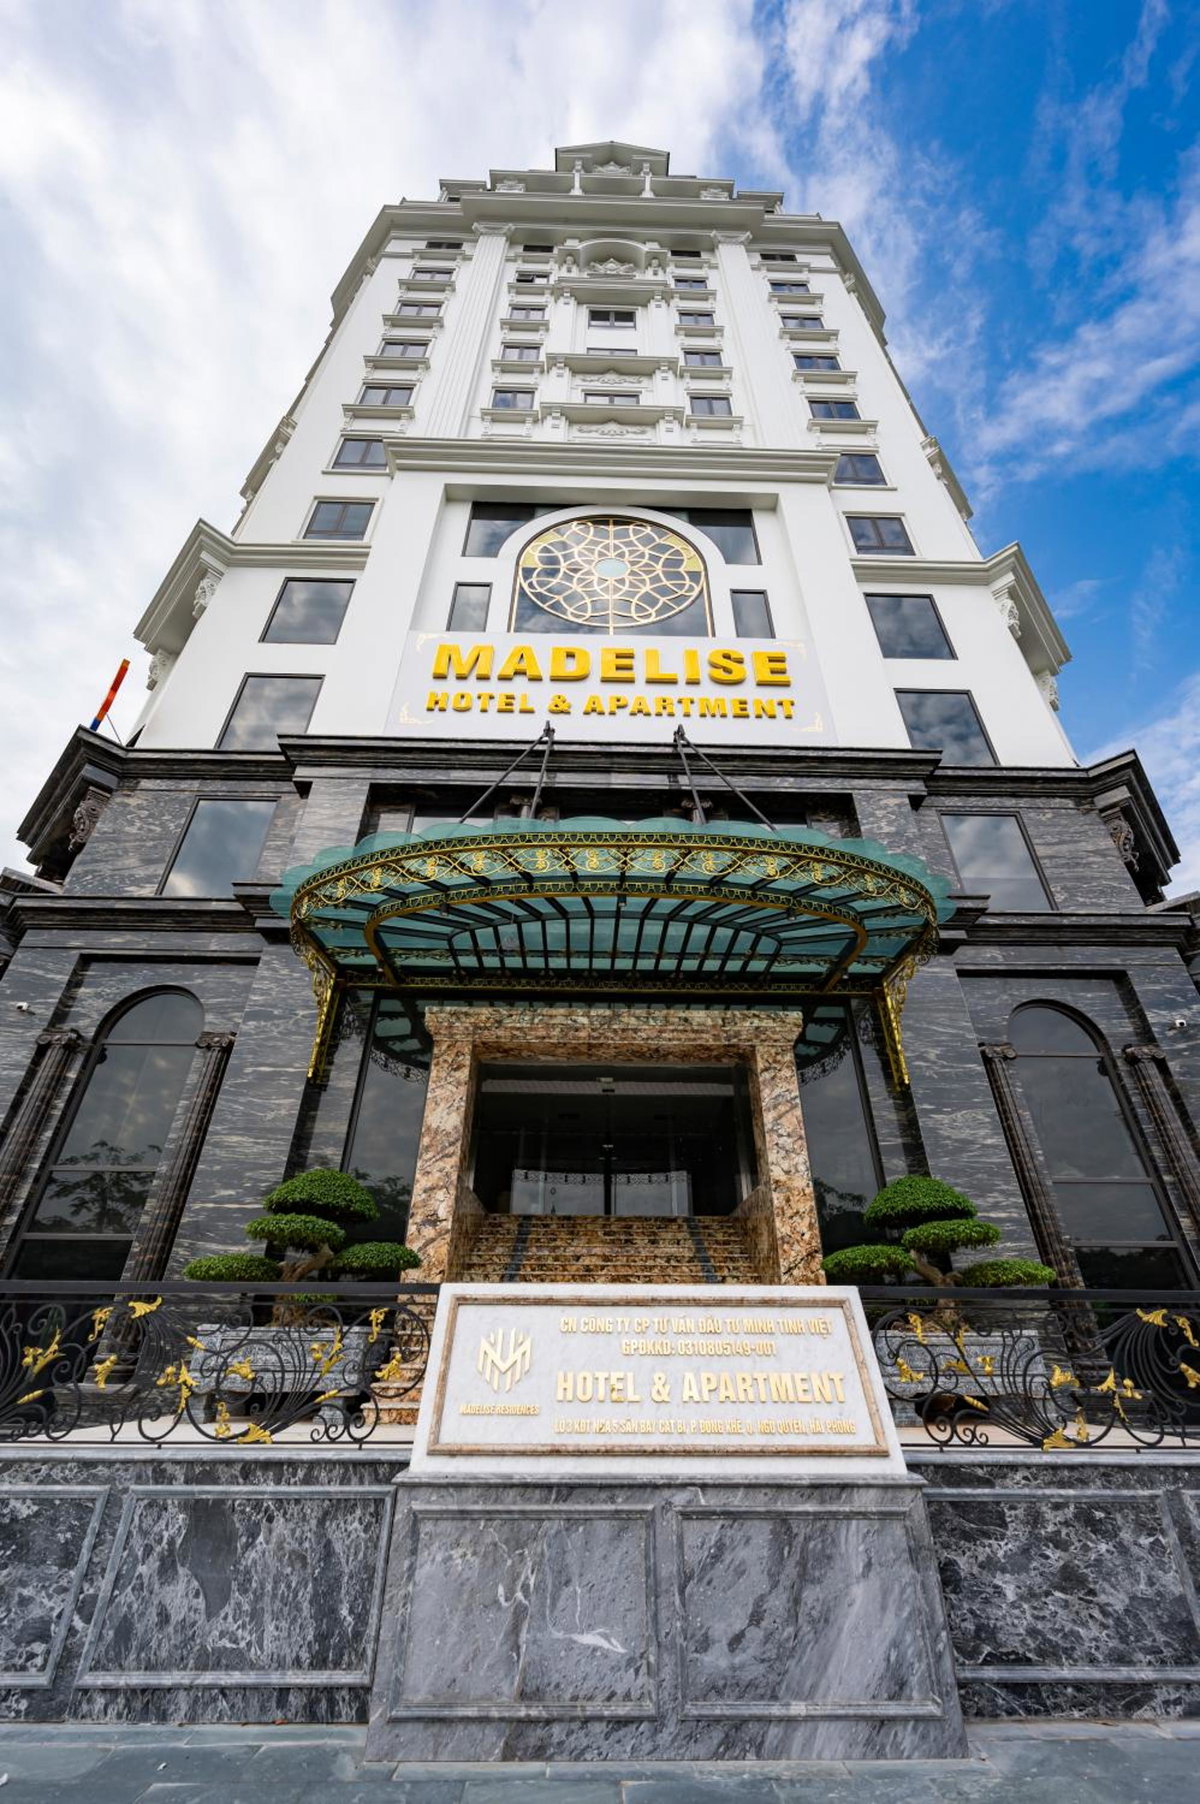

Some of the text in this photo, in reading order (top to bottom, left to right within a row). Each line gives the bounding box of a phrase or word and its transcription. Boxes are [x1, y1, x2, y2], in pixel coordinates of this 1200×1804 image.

[432, 643, 792, 686] MADELISE
[426, 691, 795, 719] HOTEL & APARTMENT
[560, 1317, 576, 1333] CN
[580, 1314, 613, 1334] CÔNG
[616, 1317, 631, 1333] TY
[634, 1317, 650, 1334] CP
[742, 1318, 775, 1334] MINH
[807, 1316, 833, 1339] VIỆT
[556, 1372, 847, 1404] HOTEL & APARTMENT
